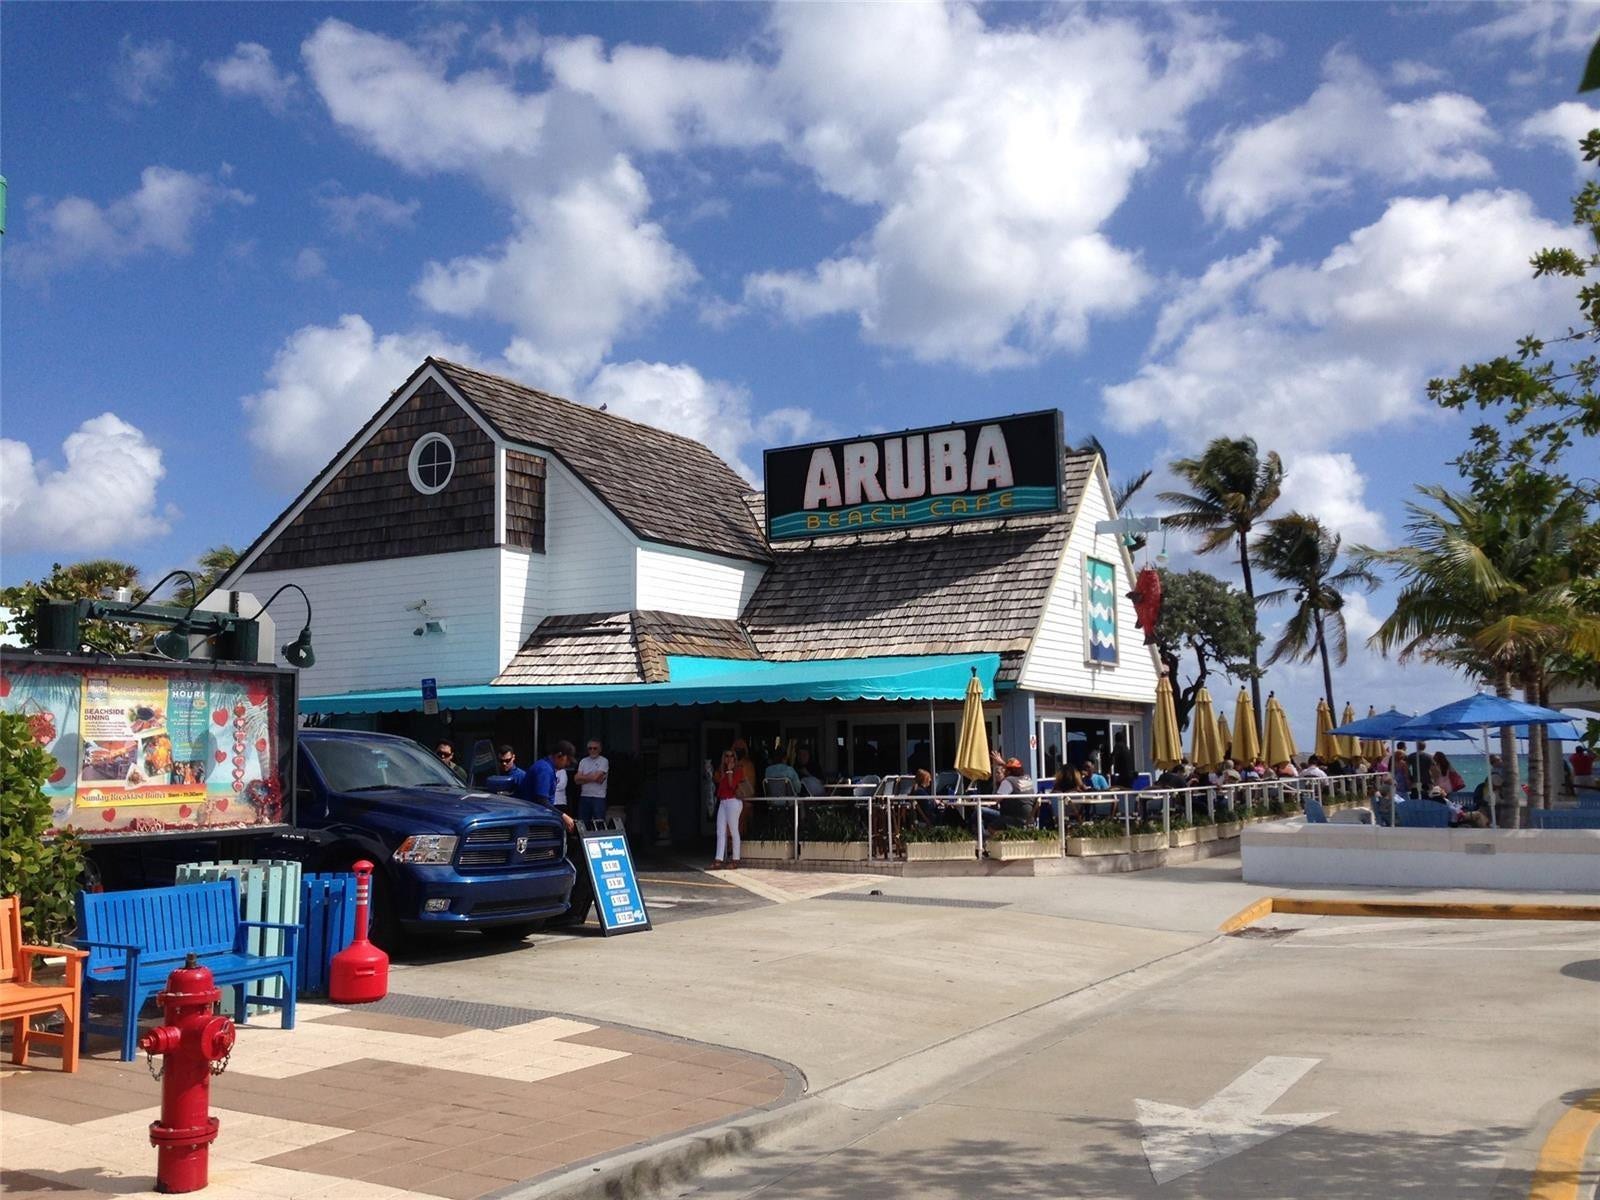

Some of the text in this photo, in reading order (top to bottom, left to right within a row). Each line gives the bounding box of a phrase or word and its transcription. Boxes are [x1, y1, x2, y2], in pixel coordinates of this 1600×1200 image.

[803, 424, 1015, 510] ARUBA
[807, 492, 1014, 529] BEACH CAFE
[81, 793, 109, 802] Sunday
[110, 792, 144, 801] Breakfast
[145, 791, 166, 799] Buffet
